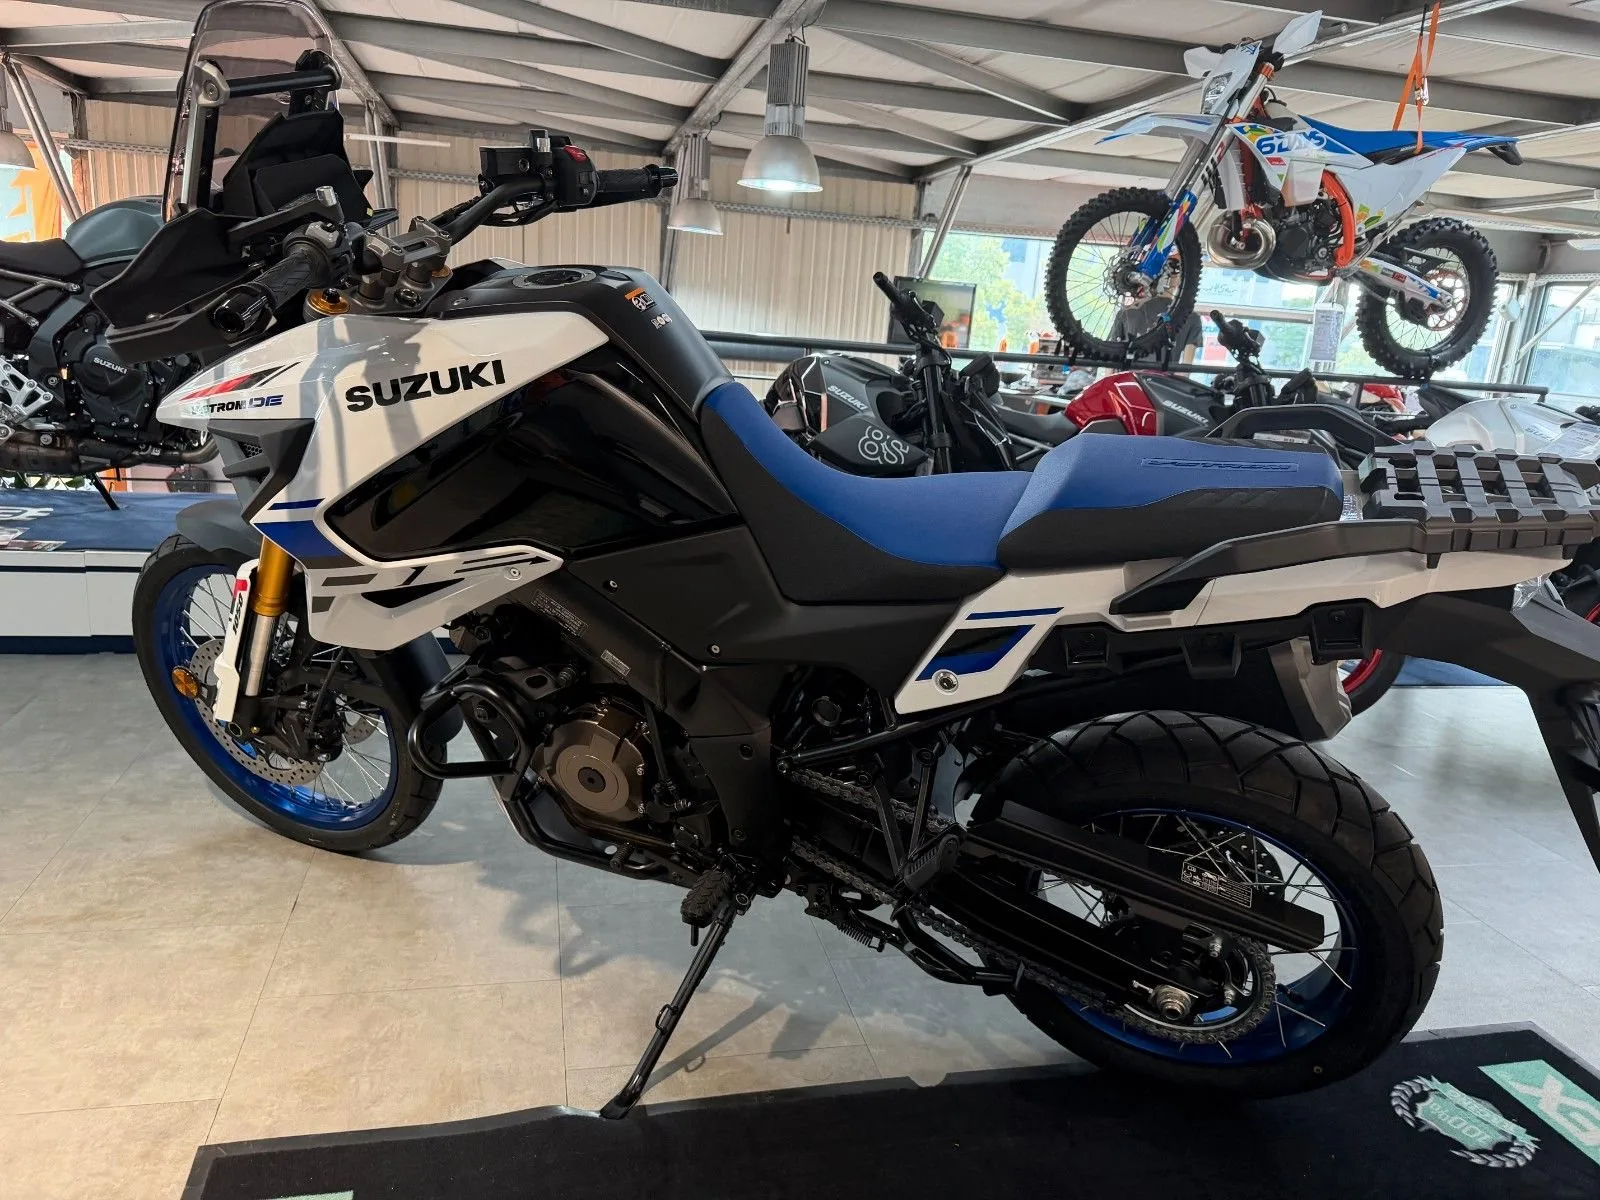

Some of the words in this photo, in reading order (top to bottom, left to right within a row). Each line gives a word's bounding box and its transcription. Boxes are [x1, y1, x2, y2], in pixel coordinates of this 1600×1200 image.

[93, 357, 128, 374] SUZUKI
[345, 359, 506, 413] SUZUKI
[828, 385, 868, 410] SUZUKI
[1162, 400, 1209, 423] SUZUKI
[232, 592, 244, 636] 1050
[1430, 1102, 1491, 1143] 100%
